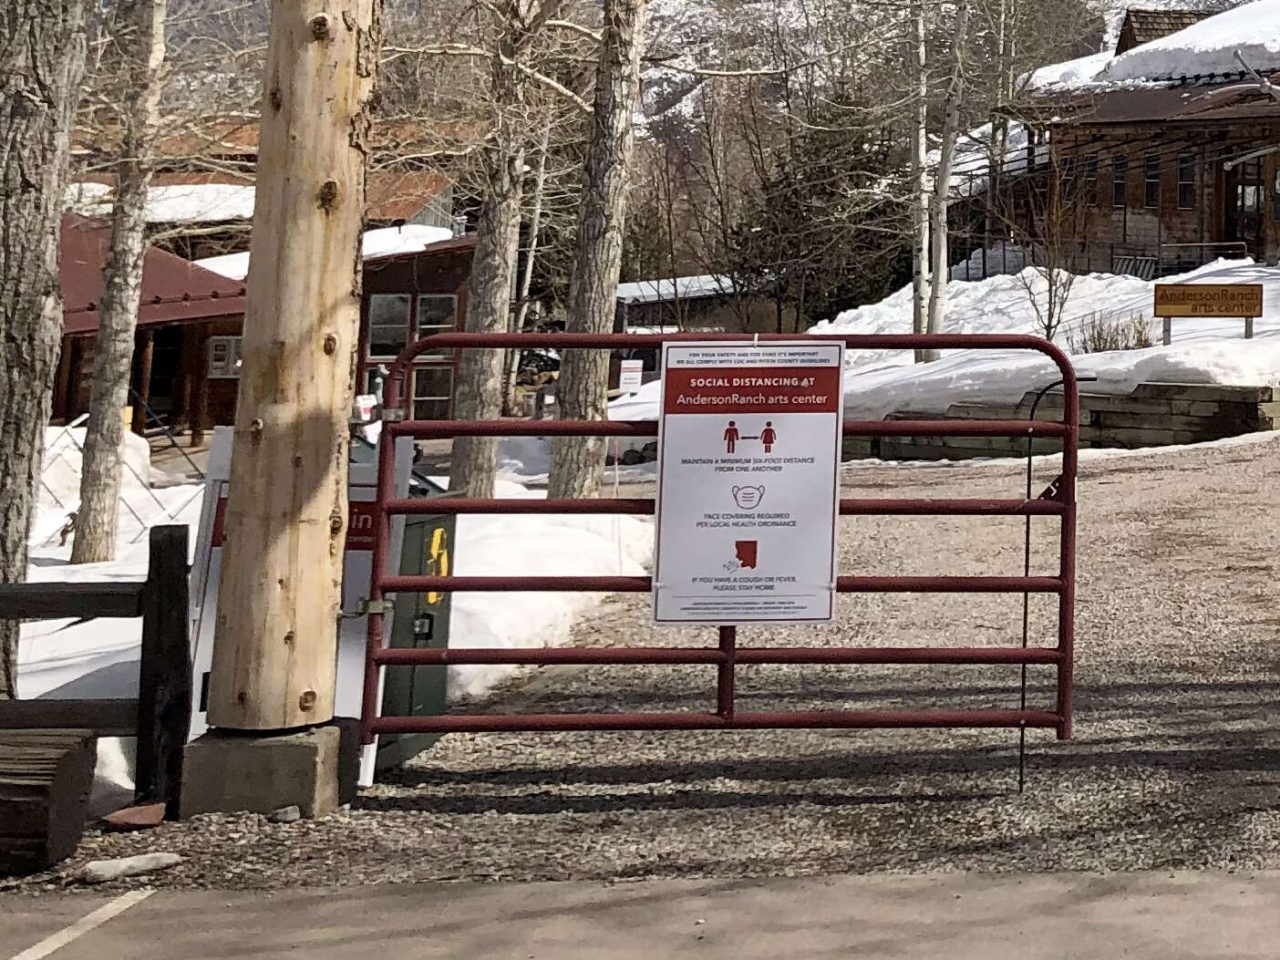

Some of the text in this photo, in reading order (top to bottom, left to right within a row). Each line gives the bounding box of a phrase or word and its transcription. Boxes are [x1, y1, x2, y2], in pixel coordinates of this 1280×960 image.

[1159, 288, 1259, 301] AndersonRanch
[1190, 303, 1257, 313] arts center
[690, 377, 815, 387] SOCIAL DISTANCING AT
[676, 393, 828, 405] AndersonRanch arts center
